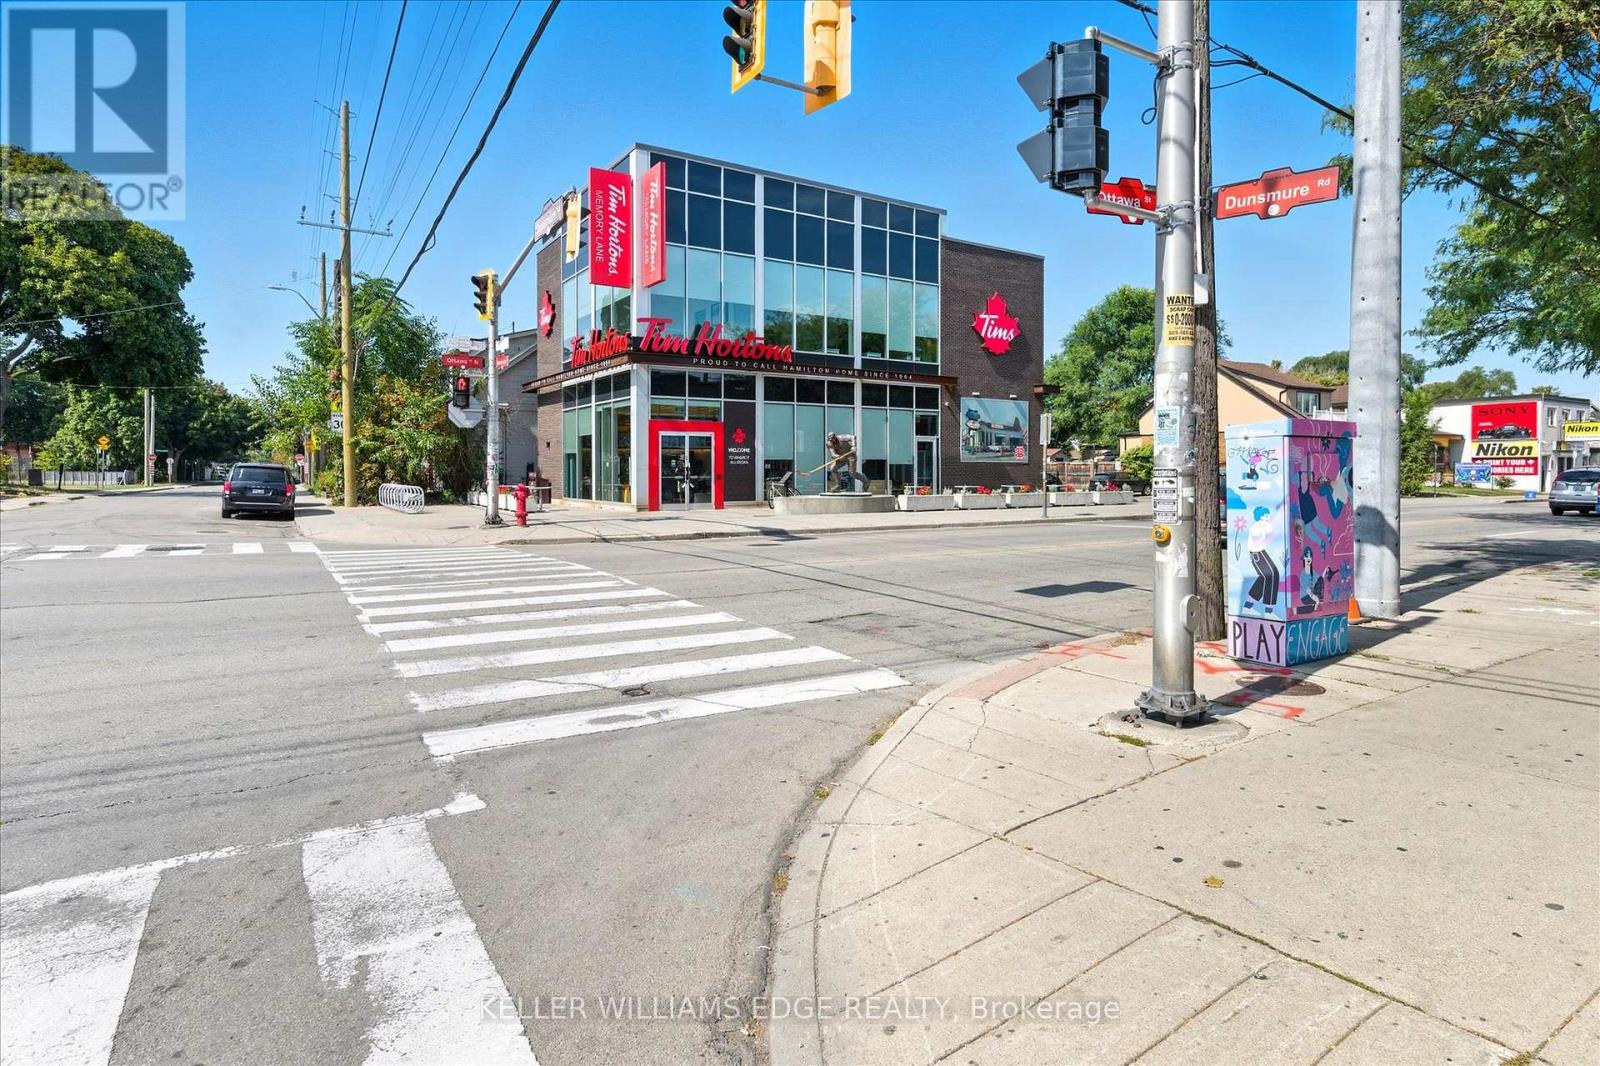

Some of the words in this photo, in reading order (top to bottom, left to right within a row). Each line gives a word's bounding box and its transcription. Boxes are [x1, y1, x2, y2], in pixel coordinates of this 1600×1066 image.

[608, 184, 626, 213] Tim
[650, 177, 658, 209] Tim
[1098, 191, 1140, 208] Ottawa
[1225, 186, 1309, 209] Dunsmure
[1317, 178, 1331, 187] Rd
[595, 190, 604, 234] MEMORY
[595, 237, 604, 262] LANE
[608, 214, 627, 275] Hortons
[650, 212, 658, 272] Hortons
[637, 318, 689, 354] Tim
[694, 320, 792, 362] Hortons
[979, 314, 1015, 341] Tims
[570, 336, 590, 367] Tim
[590, 327, 631, 361] Hortons
[693, 358, 728, 366] PROUD
[783, 365, 829, 373] HAMILTON
[835, 369, 859, 377] HOME
[864, 371, 889, 379] SINCE
[1478, 405, 1529, 415] SONY
[1475, 443, 1533, 456] Nikon
[1232, 620, 1284, 663] PLAY
[1286, 616, 1347, 664] ENGAGE
